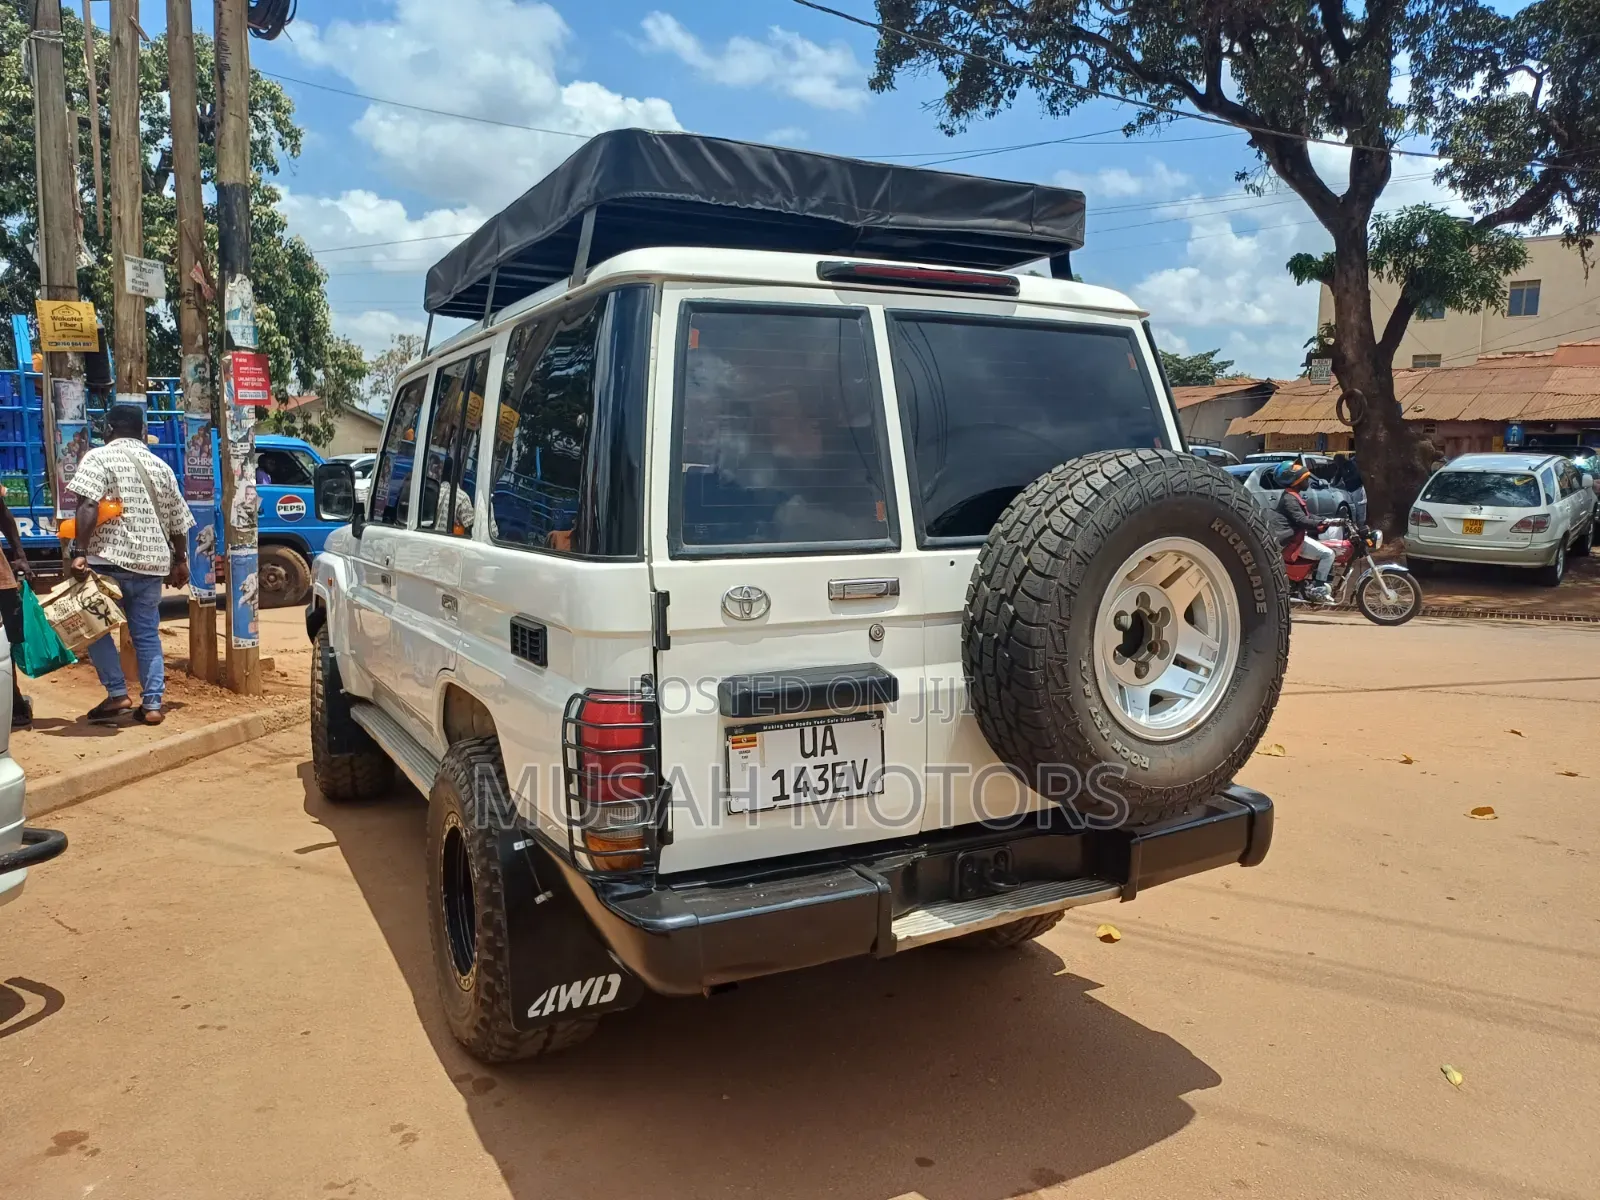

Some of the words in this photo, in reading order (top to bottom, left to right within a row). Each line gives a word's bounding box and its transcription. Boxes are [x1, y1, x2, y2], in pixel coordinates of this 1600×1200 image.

[277, 504, 304, 512] PEPSI
[1209, 517, 1268, 614] ROCKBLADE
[800, 725, 838, 759] UA
[1111, 739, 1150, 770] ROCK
[771, 757, 869, 801] 143EV
[527, 973, 622, 1019] 4WD
